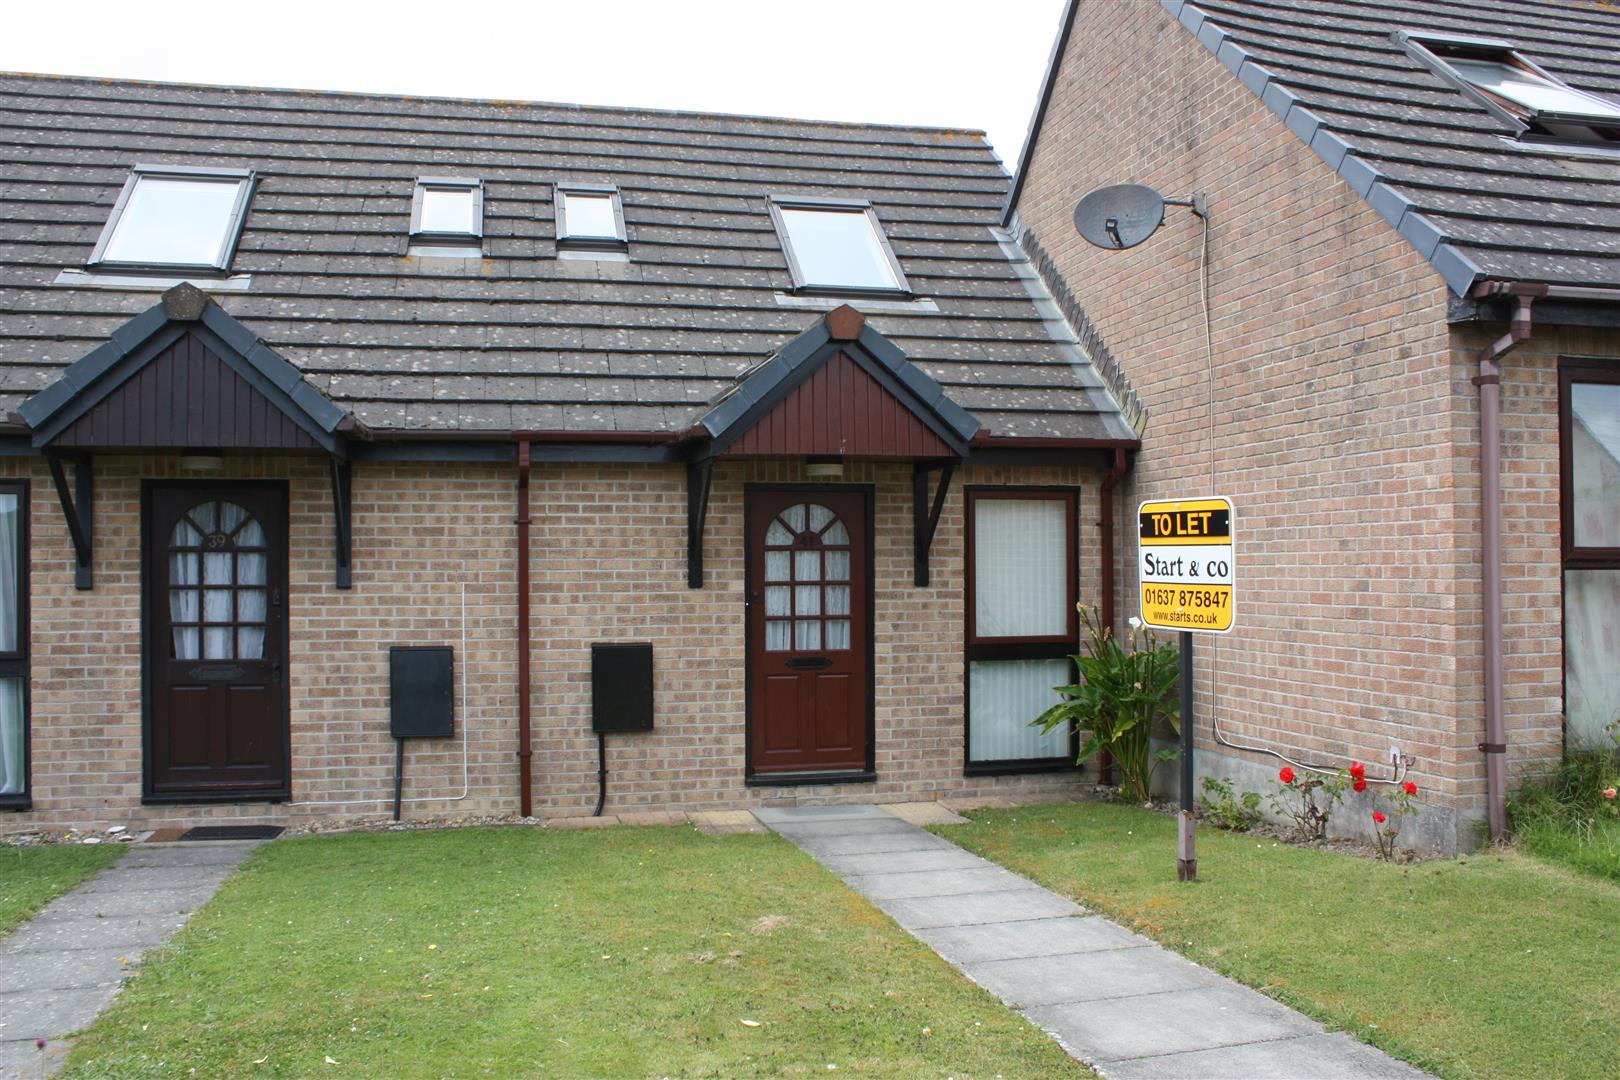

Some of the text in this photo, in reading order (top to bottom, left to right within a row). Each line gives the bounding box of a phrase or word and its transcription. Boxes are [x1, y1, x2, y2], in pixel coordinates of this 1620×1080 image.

[1152, 512, 1212, 536] TO LET
[208, 534, 225, 548] 39
[1145, 553, 1183, 576] Start
[1189, 560, 1200, 576] &
[1145, 588, 1228, 608] 01637 875847
[1153, 611, 1218, 624] www.starts.co.uk
